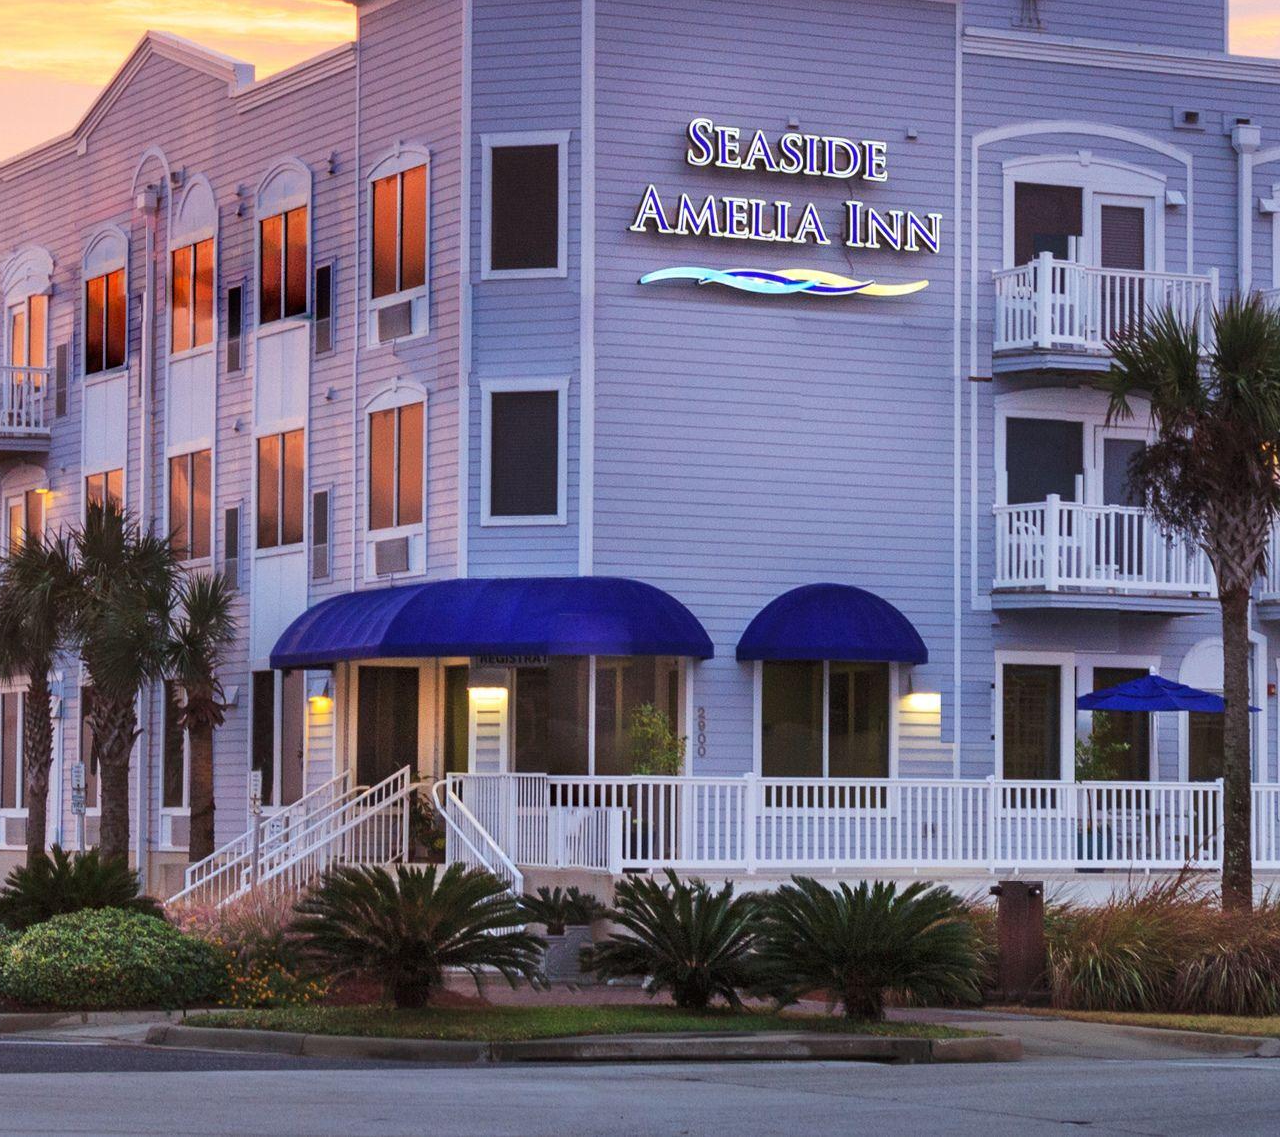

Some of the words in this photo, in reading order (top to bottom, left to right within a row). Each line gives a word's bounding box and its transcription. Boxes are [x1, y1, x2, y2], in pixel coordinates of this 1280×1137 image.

[687, 117, 888, 182] SEASIDE
[629, 184, 831, 246] AMELIA
[845, 200, 943, 254] INN
[697, 707, 706, 757] 2900
